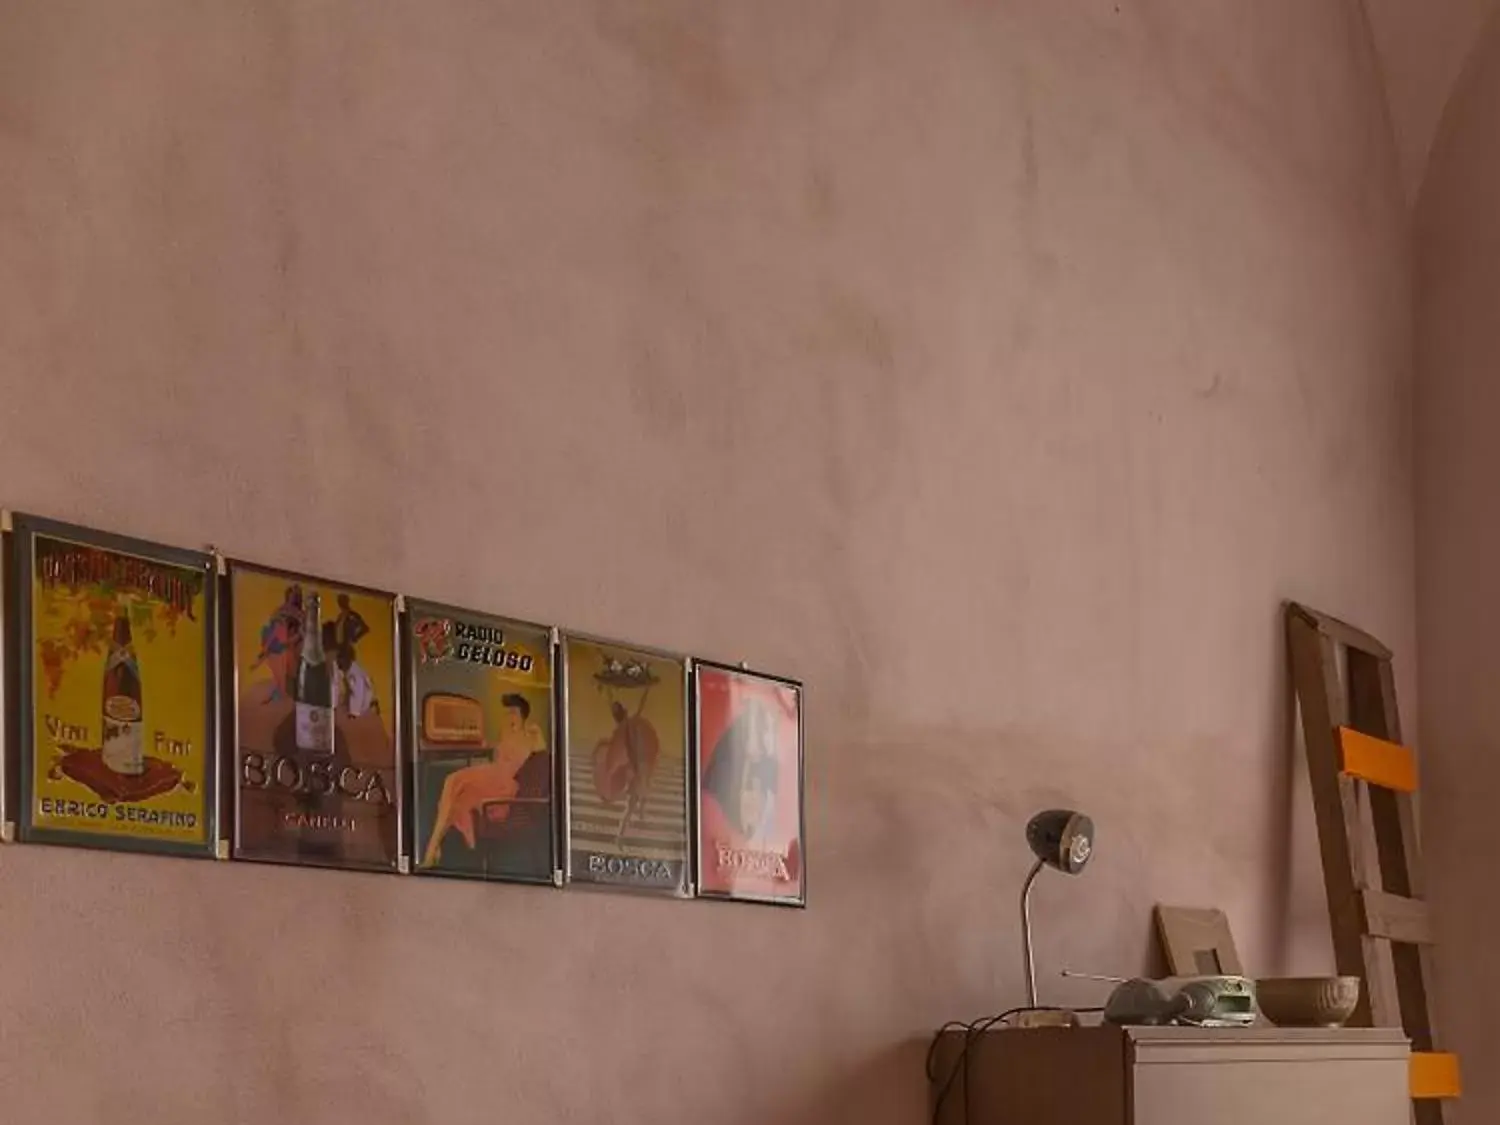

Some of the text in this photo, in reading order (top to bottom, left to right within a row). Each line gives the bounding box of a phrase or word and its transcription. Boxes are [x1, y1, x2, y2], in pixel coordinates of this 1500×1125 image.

[455, 621, 504, 645] RADIO
[458, 643, 534, 672] GELOSO
[243, 752, 393, 806] BOSCA
[39, 798, 109, 819] ENRICO
[114, 804, 198, 828] SERAFINO
[588, 854, 673, 880] BOSCA
